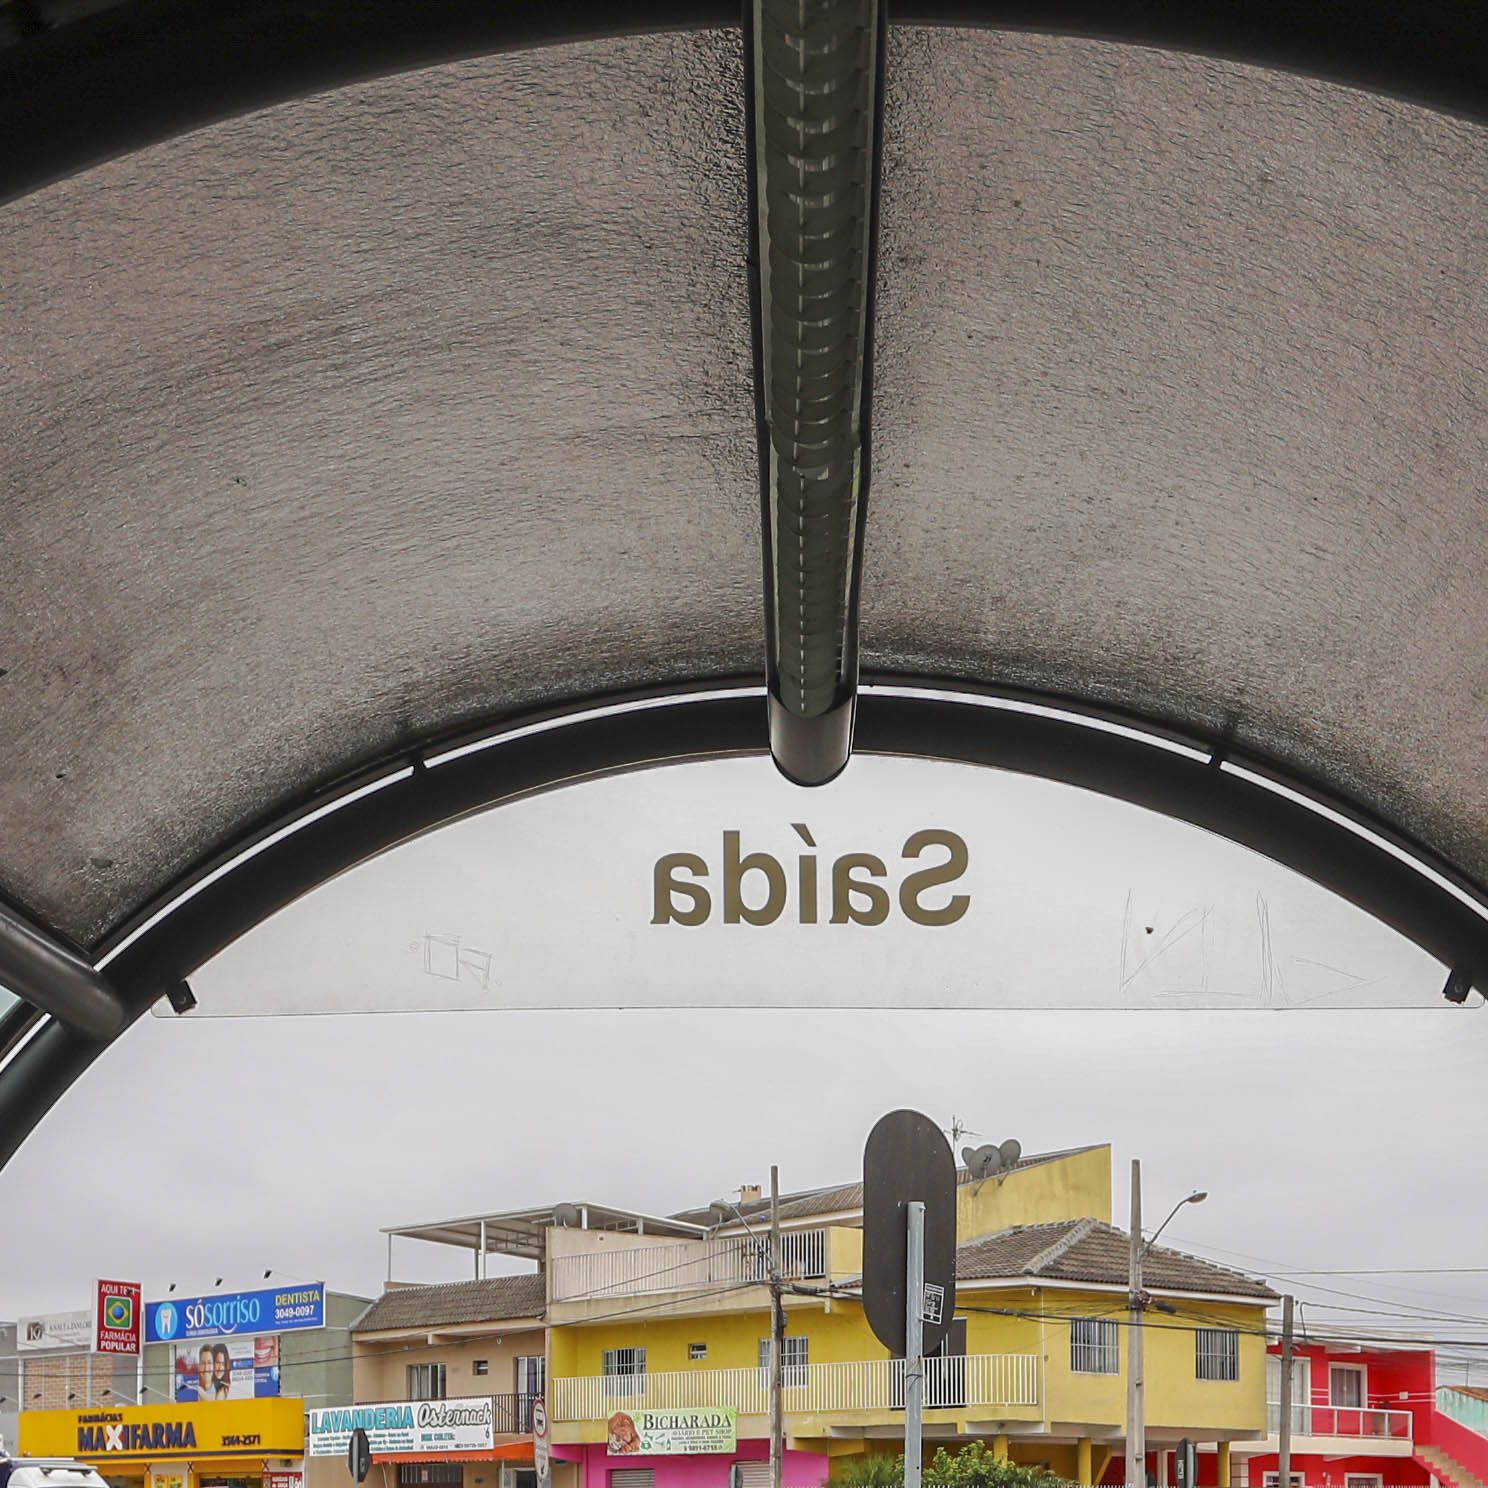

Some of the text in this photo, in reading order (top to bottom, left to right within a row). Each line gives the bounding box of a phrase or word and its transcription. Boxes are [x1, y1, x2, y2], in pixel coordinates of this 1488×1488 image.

[100, 1283, 118, 1295] AQUI
[275, 1290, 321, 1306] DENTISTA
[274, 1305, 315, 1319] 3049-0097
[100, 1330, 137, 1342] FARMÁCIA
[100, 1341, 137, 1352] POPULAR
[312, 1402, 492, 1434] LAVANDERIA Osternack
[643, 1413, 732, 1430] BICHARADA
[77, 1421, 197, 1451] MAXIFARMA
